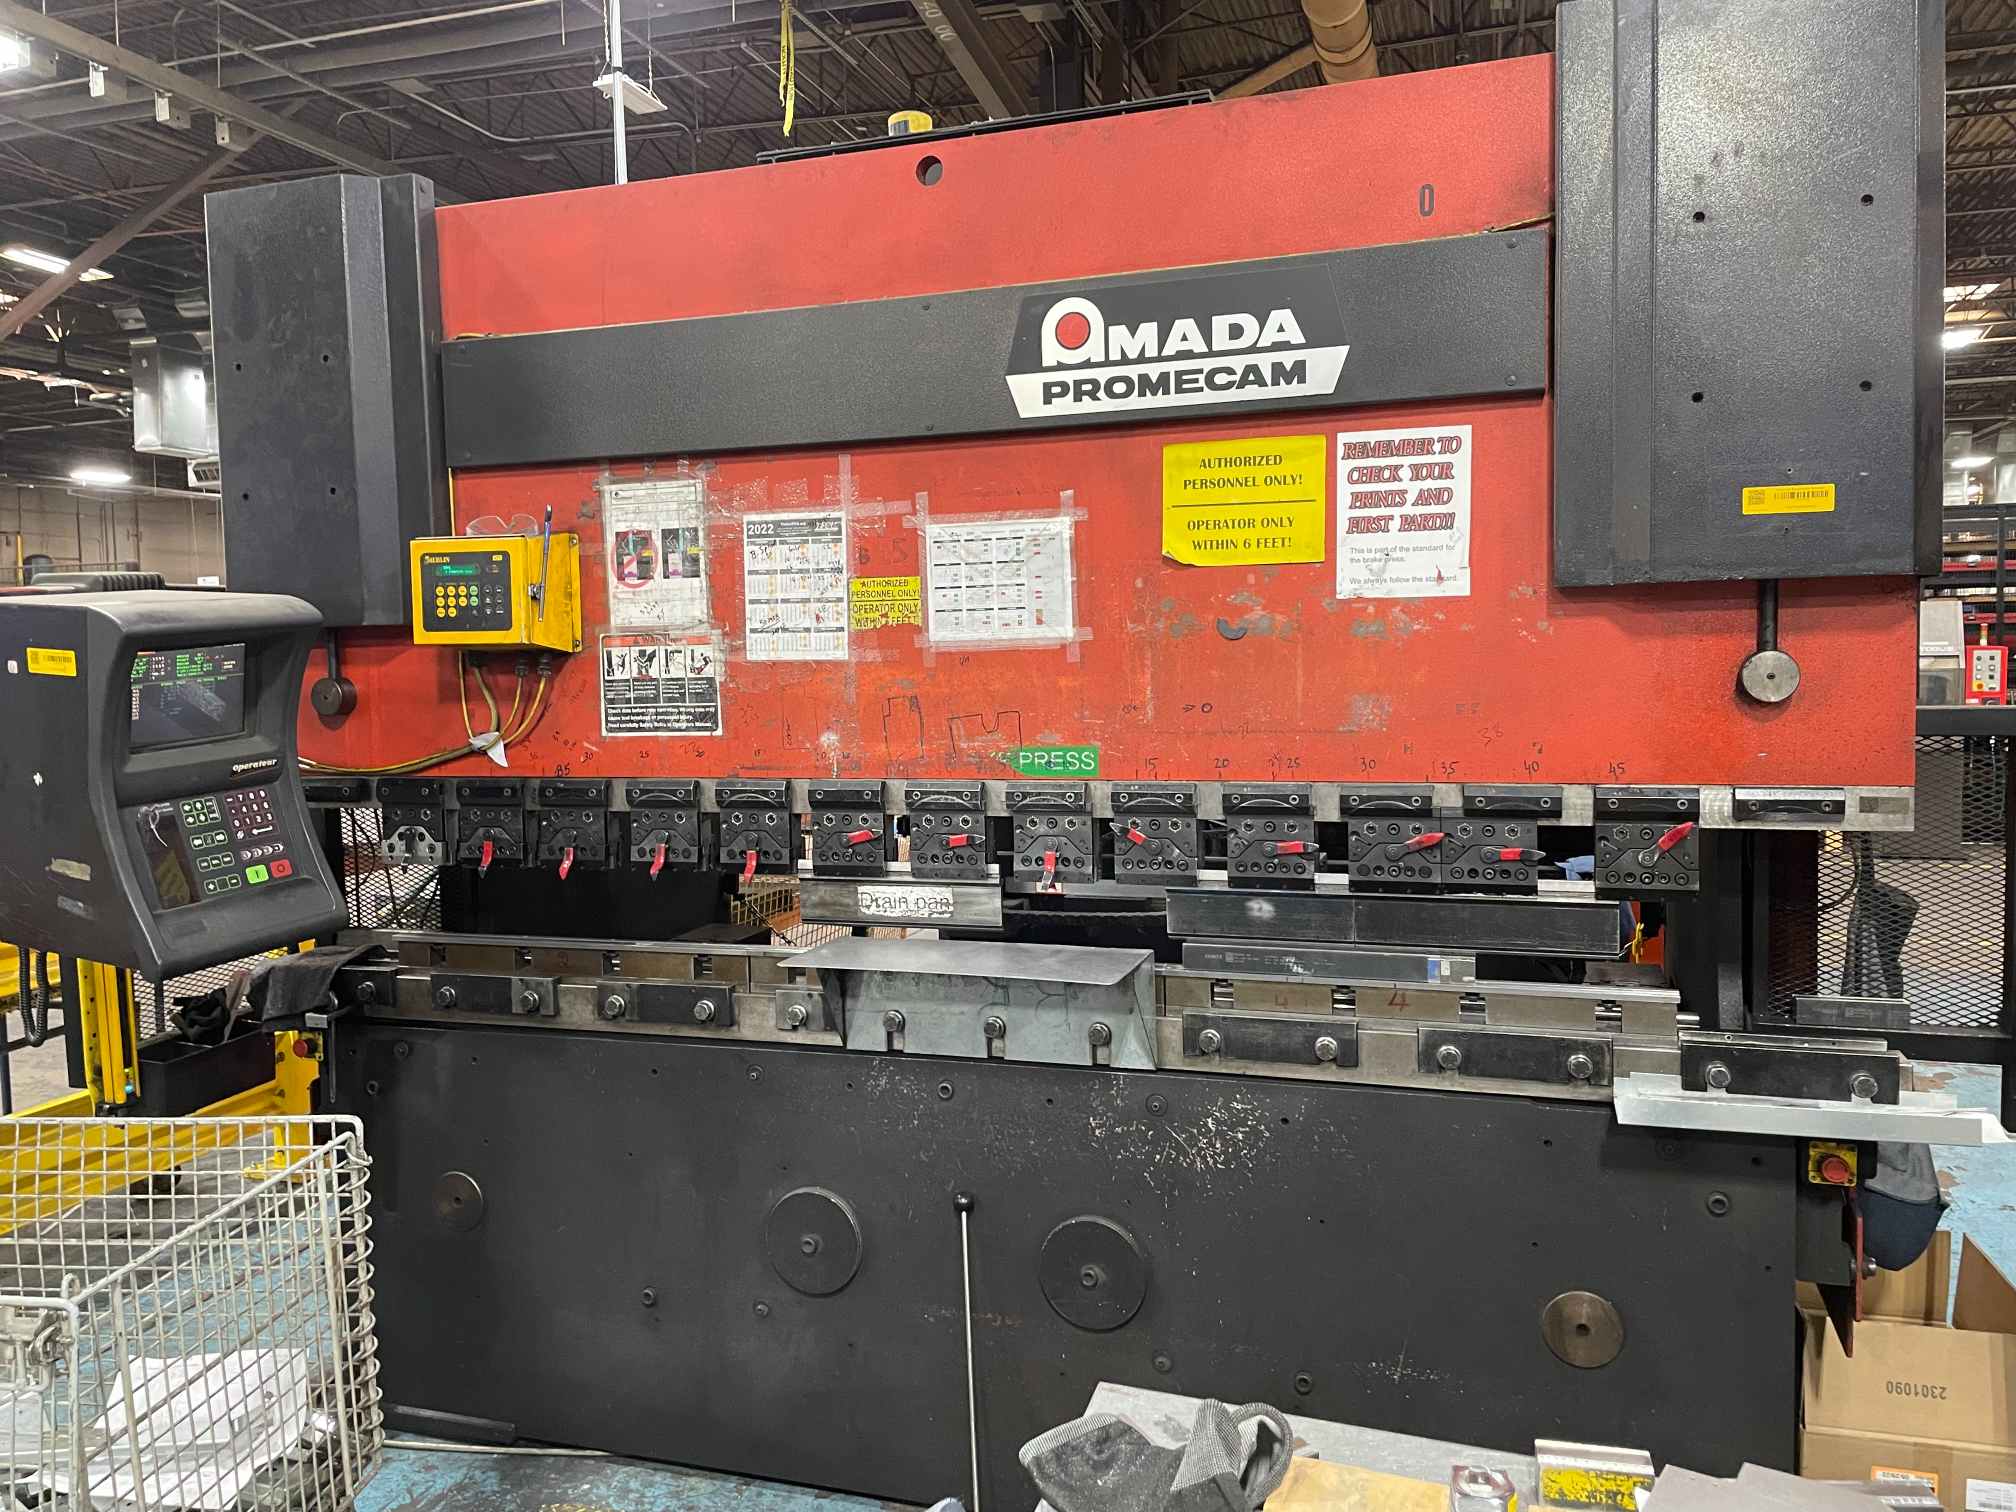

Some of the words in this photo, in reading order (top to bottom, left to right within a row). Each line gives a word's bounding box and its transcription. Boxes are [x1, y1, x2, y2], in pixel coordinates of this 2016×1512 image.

[1041, 297, 1306, 367] AMADA
[1042, 359, 1307, 406] PROMECAM
[1341, 437, 1436, 460] REMEMBER
[1437, 436, 1462, 455] TO
[1200, 454, 1283, 470] AUTHORIZED
[1347, 464, 1404, 484] CHECK
[1408, 462, 1455, 482] YOUR
[1183, 476, 1259, 490] PERSONNEL
[1264, 474, 1303, 486] ONLY!
[1348, 489, 1408, 509] PRINTS
[1411, 487, 1453, 507] AND
[749, 524, 774, 535] 2022
[1187, 517, 1256, 531] OPERATOR
[1261, 516, 1295, 528] ONLY
[1345, 514, 1394, 535] FIRST
[1192, 538, 1238, 551] WITHIN
[1243, 538, 1252, 549] 6
[1256, 536, 1292, 549] FEET!
[1350, 546, 1365, 555] This
[1374, 546, 1389, 555] part
[1389, 545, 1398, 553] of
[1398, 545, 1410, 553] the
[1411, 544, 1444, 553] standard
[1445, 544, 1456, 552] for
[1349, 556, 1361, 564] the
[1362, 556, 1383, 564] brake
[861, 579, 909, 588] AUTHORIZED
[1350, 577, 1362, 585] We
[1363, 576, 1388, 586] always
[1389, 575, 1410, 584] follow
[1411, 575, 1423, 583] the
[1425, 574, 1457, 583] staard
[851, 590, 896, 599] PERSONNEL
[897, 589, 920, 598] ONLY!
[852, 603, 896, 614] OPERATOR
[897, 602, 919, 613] ONLY
[1019, 752, 1095, 770] PRESS
[1144, 758, 1157, 771] 15
[1215, 758, 1229, 769] 20
[1287, 758, 1300, 769] 25
[1360, 758, 1376, 773] 30
[1441, 761, 1460, 775] 35
[1524, 760, 1540, 776] 40
[1608, 762, 1625, 776] 45
[860, 892, 908, 909] Drain
[914, 897, 953, 911] pan
[1886, 1380, 1947, 1400] 2301090
